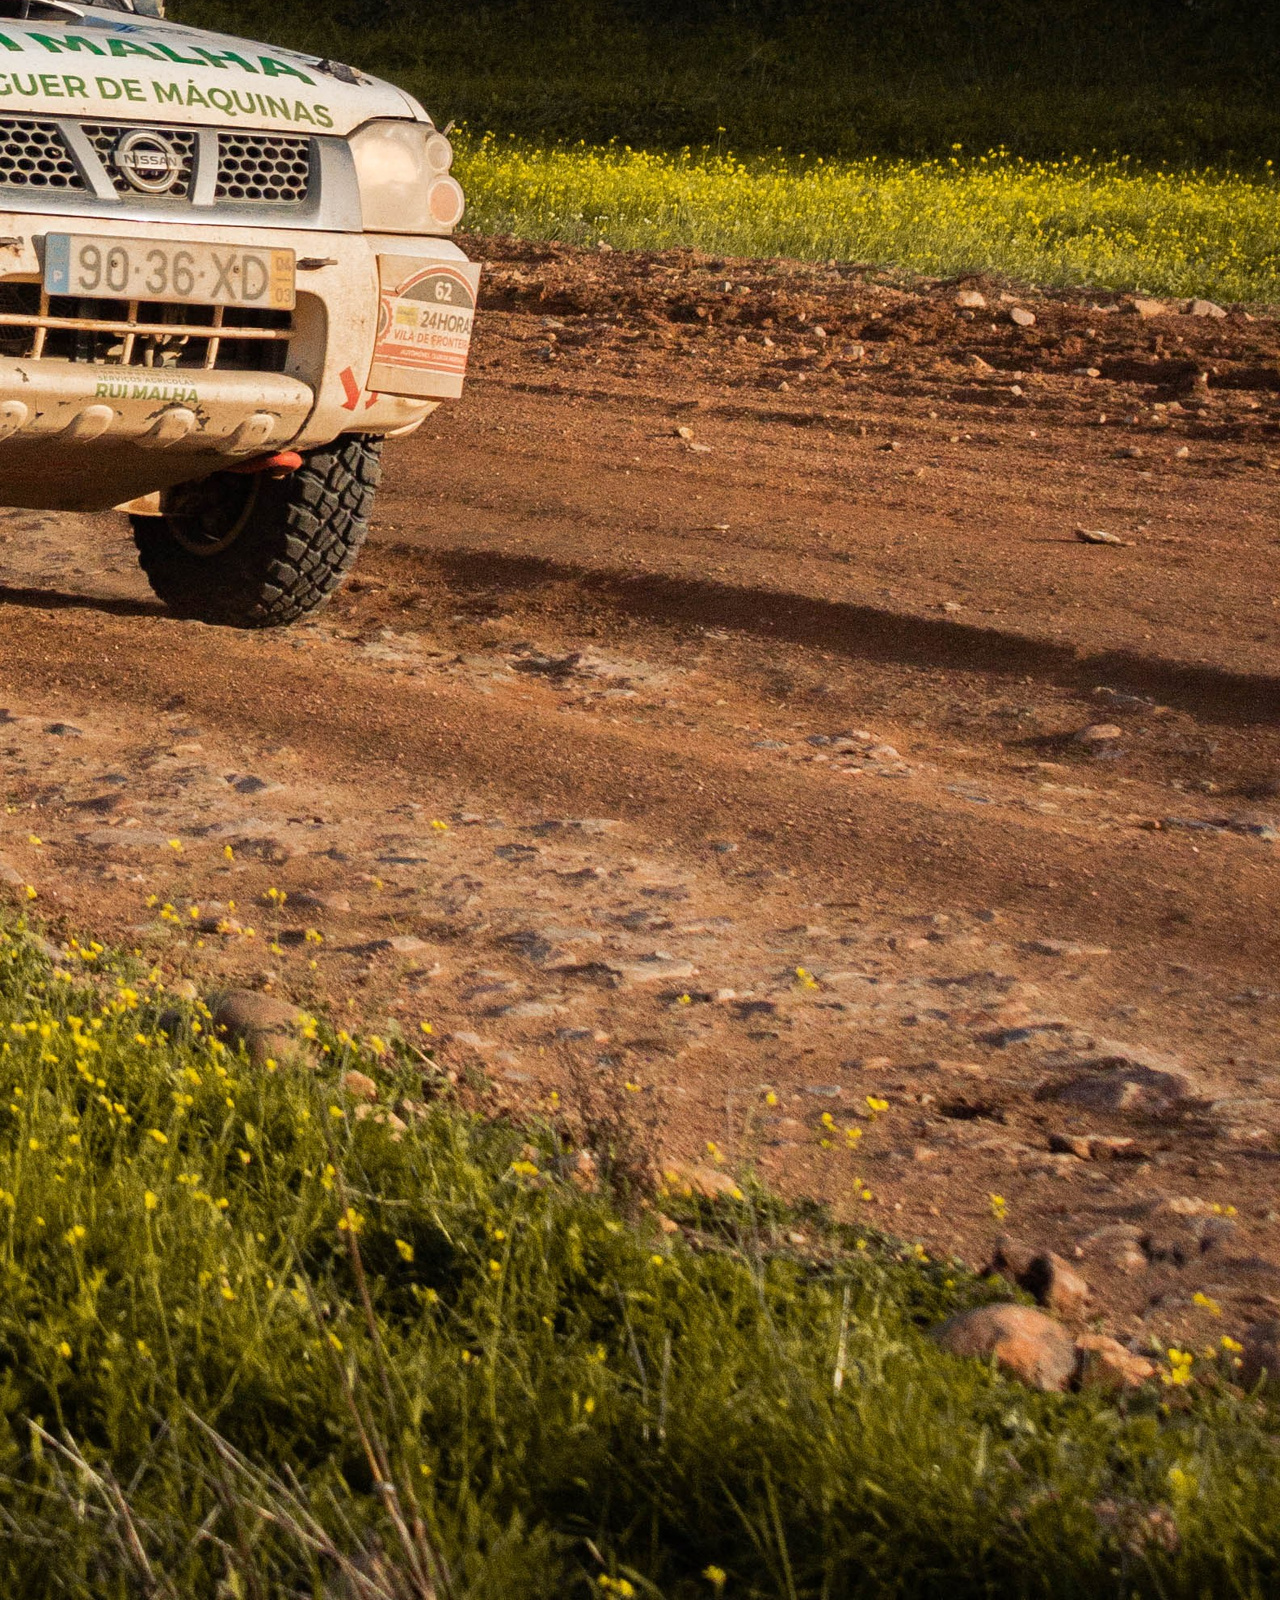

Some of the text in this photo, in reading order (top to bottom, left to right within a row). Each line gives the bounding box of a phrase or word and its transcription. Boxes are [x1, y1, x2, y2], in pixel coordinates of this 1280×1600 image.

[23, 31, 318, 87] MALHA
[97, 78, 148, 103] DE
[151, 78, 335, 128] MÁQUINAS
[123, 154, 178, 167] NISSAN
[435, 281, 452, 302] 62
[393, 329, 415, 342] VILA
[416, 332, 429, 344] DE
[95, 383, 199, 403] RUI MALHA
